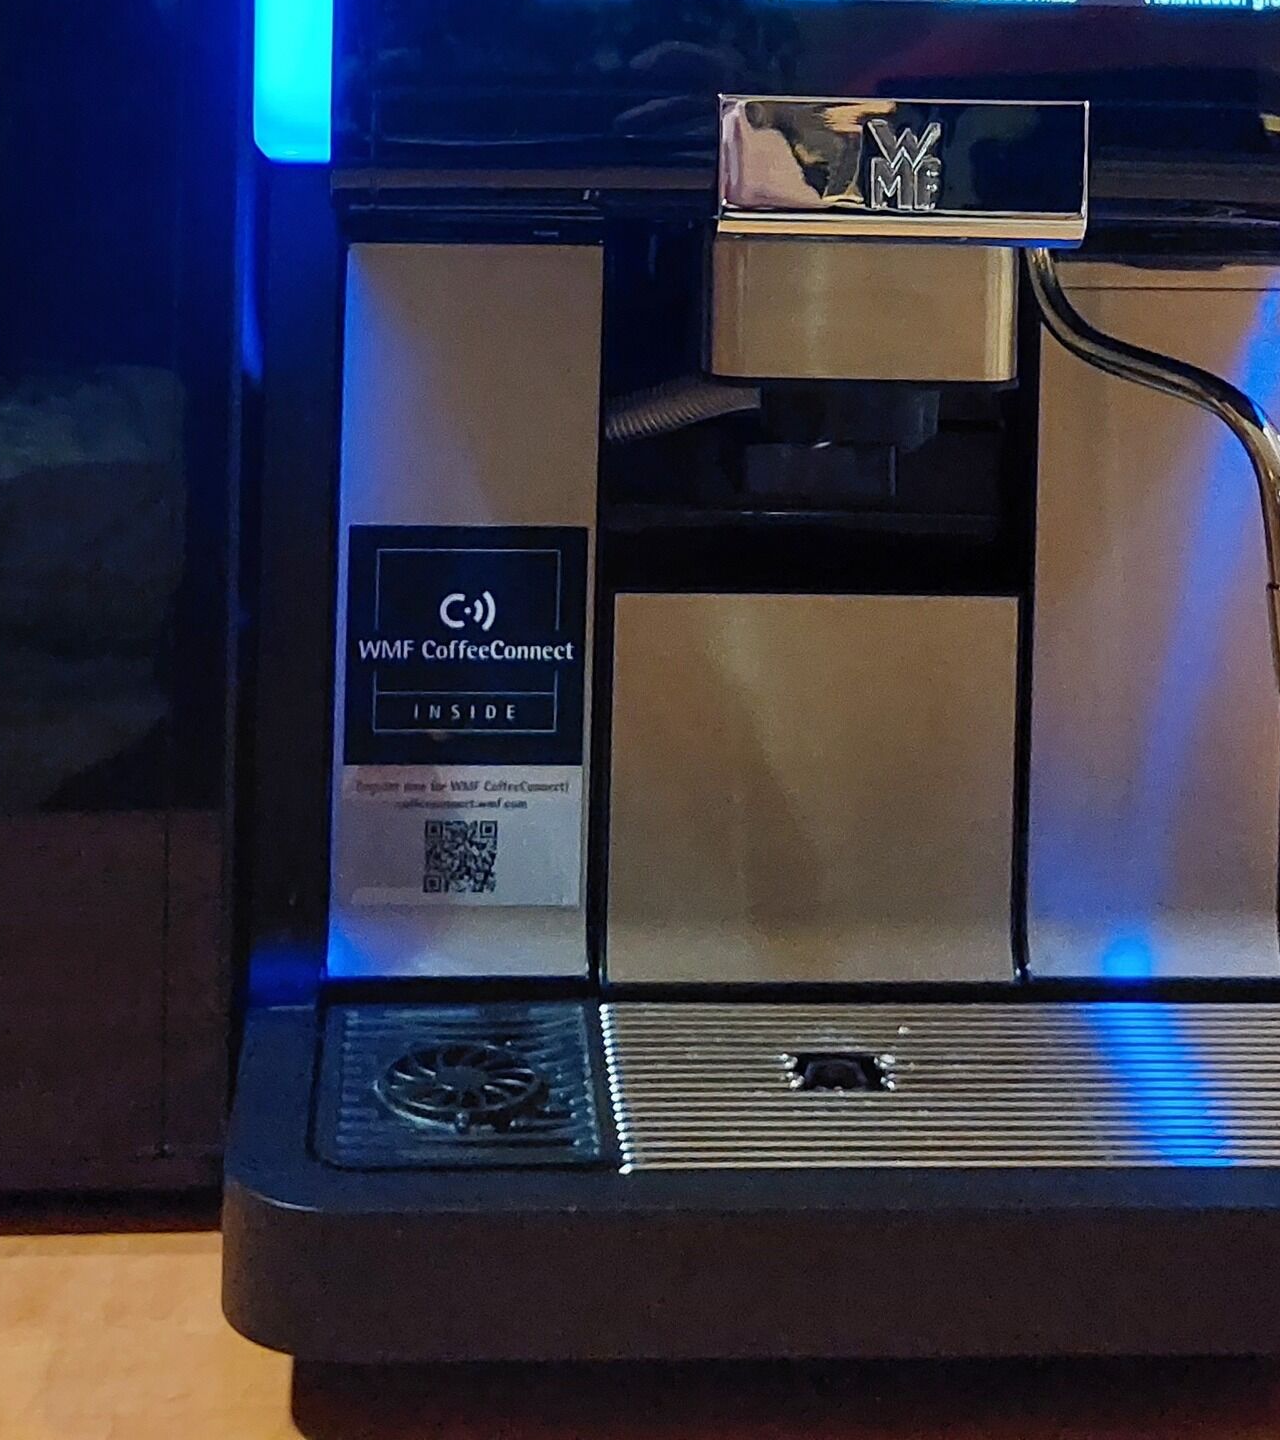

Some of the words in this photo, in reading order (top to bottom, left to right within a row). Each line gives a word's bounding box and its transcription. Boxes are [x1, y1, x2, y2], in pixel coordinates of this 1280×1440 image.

[358, 640, 414, 659] WMF
[422, 639, 575, 660] CoffeeConnect
[414, 704, 516, 720] INSIDE
